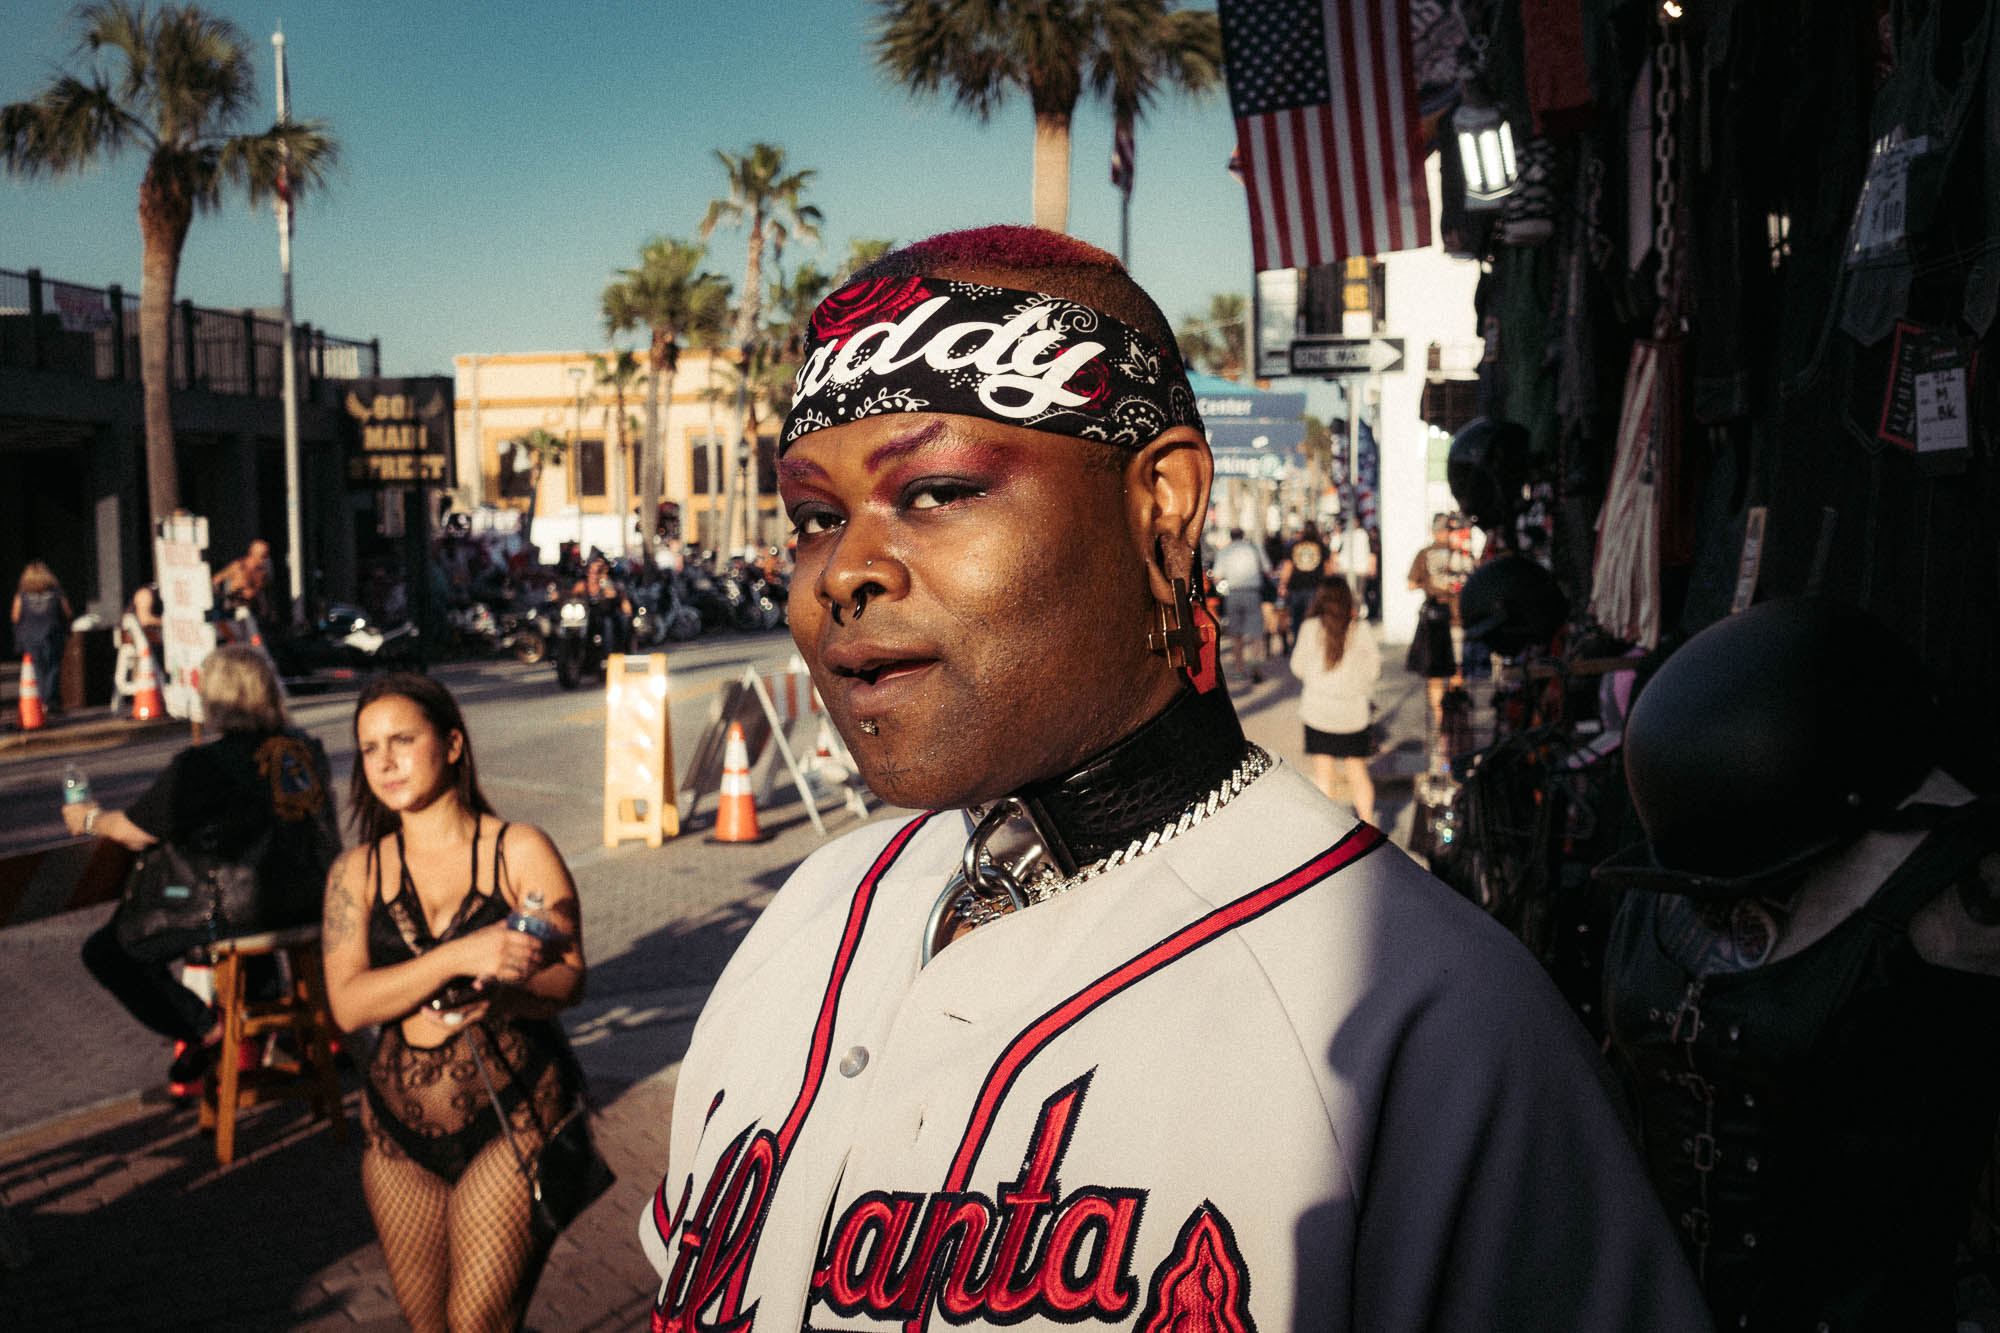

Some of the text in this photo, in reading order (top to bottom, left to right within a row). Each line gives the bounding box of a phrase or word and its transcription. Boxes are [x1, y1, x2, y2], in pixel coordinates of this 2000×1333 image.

[792, 296, 1106, 419] addy
[1297, 349, 1367, 363] ONE WAY
[1198, 397, 1253, 416] Center
[1214, 455, 1258, 478] rking
